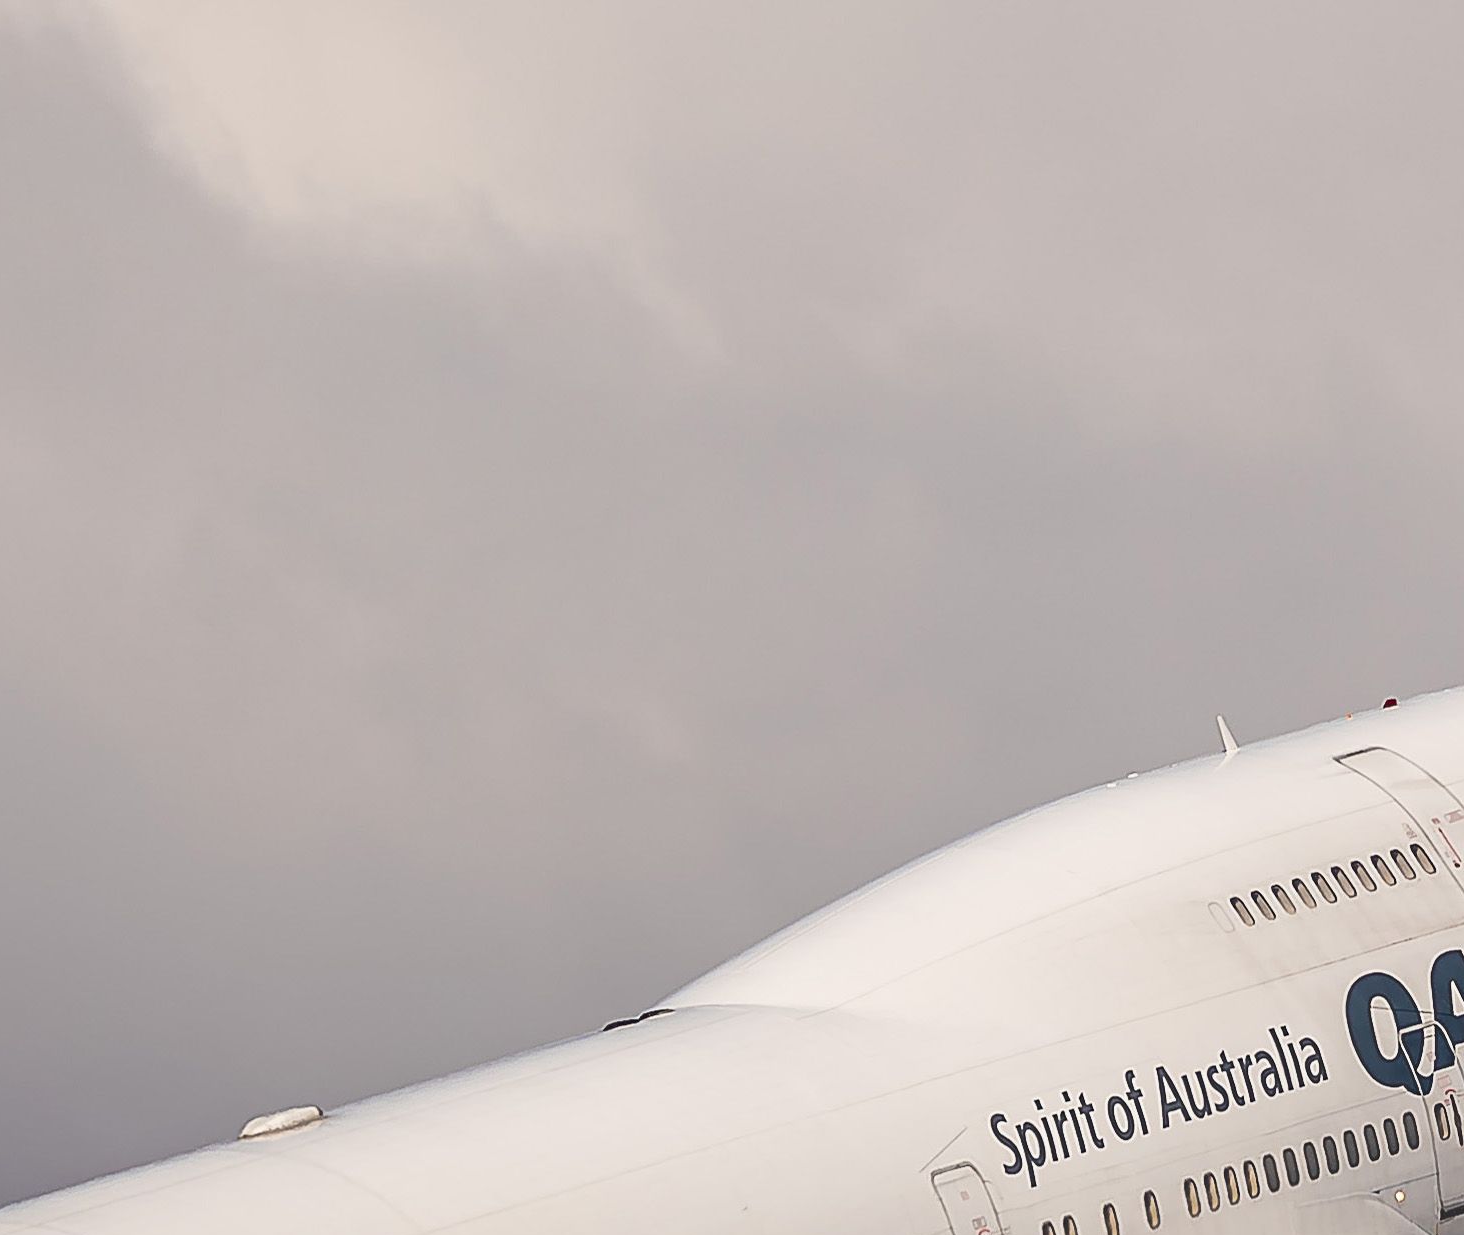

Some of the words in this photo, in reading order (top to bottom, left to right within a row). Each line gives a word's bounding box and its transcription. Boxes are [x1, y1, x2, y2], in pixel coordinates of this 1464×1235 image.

[990, 1090, 1105, 1188] Spirit
[1107, 1070, 1149, 1141] of
[1155, 1025, 1329, 1129] Australia
